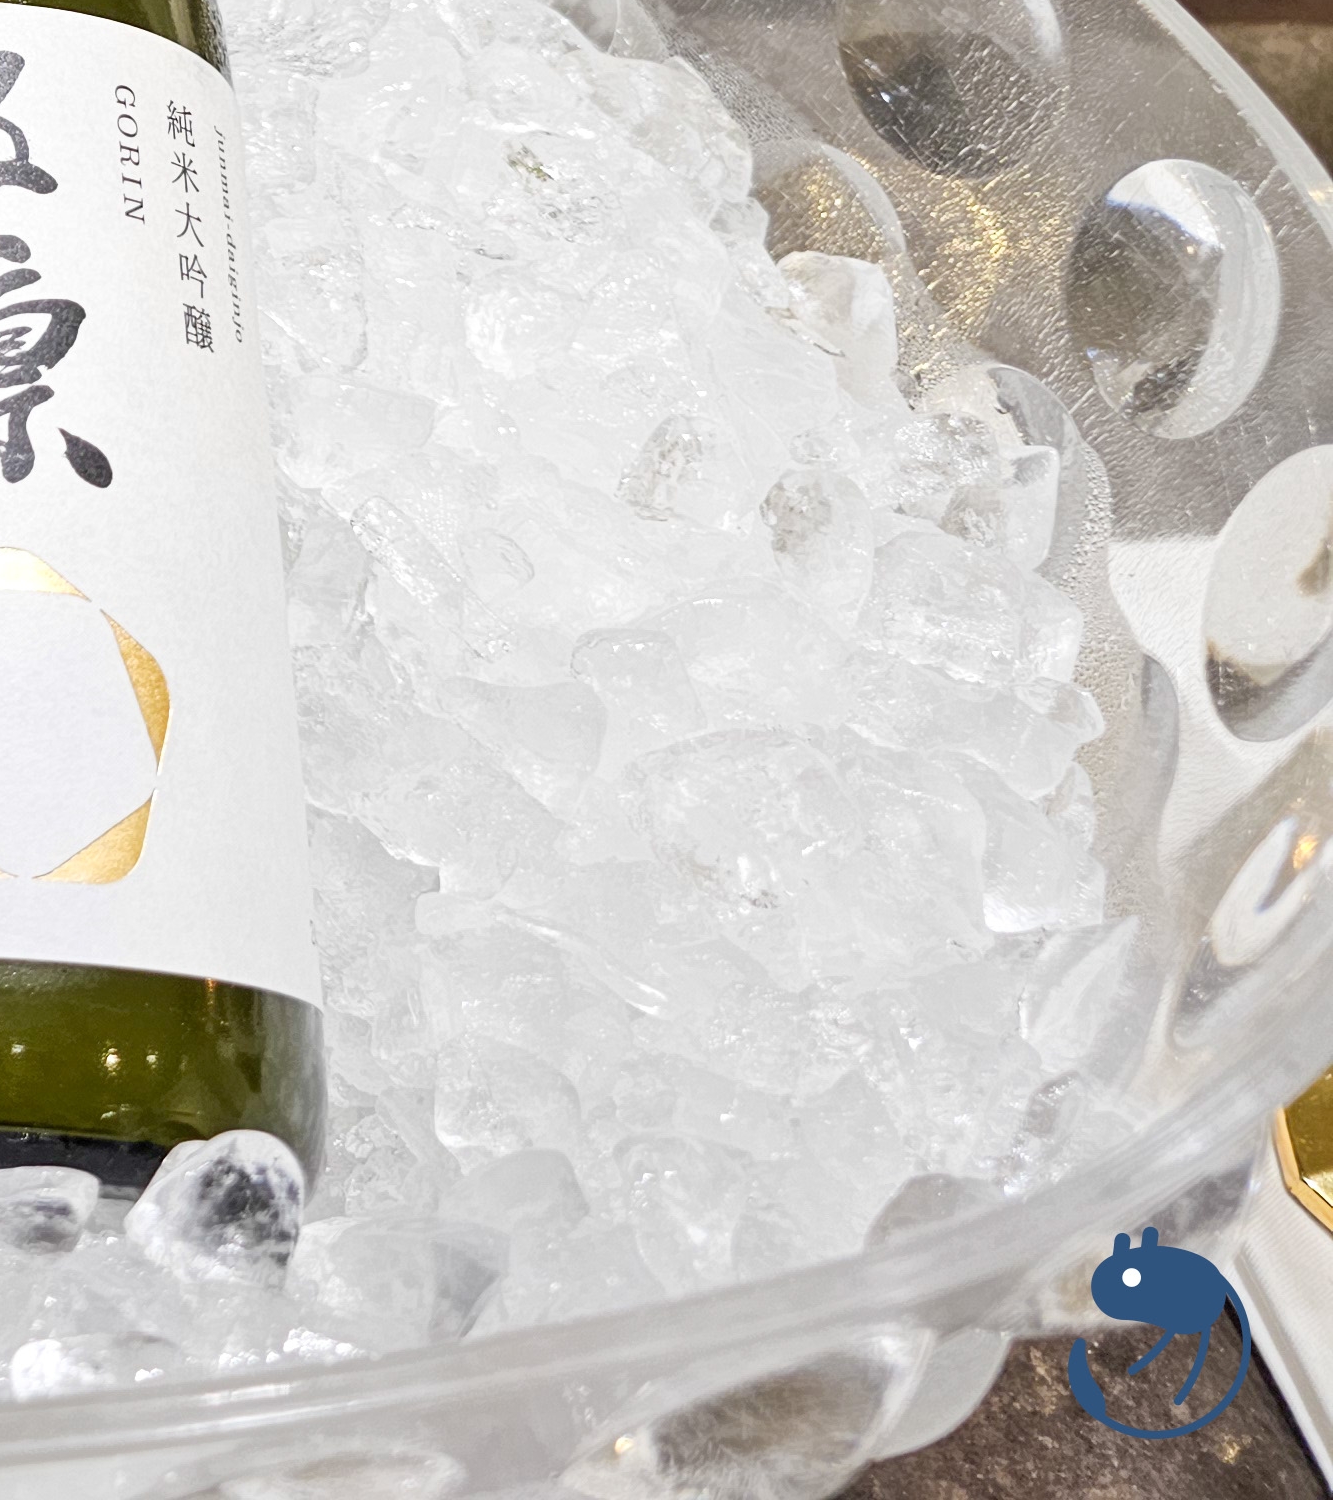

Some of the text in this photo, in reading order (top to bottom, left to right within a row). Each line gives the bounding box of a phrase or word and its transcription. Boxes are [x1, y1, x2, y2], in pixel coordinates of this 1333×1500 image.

[114, 84, 146, 225] GORIN
[166, 99, 215, 353] 純米大吟醸
[214, 125, 243, 344] junmai-daiginjo
